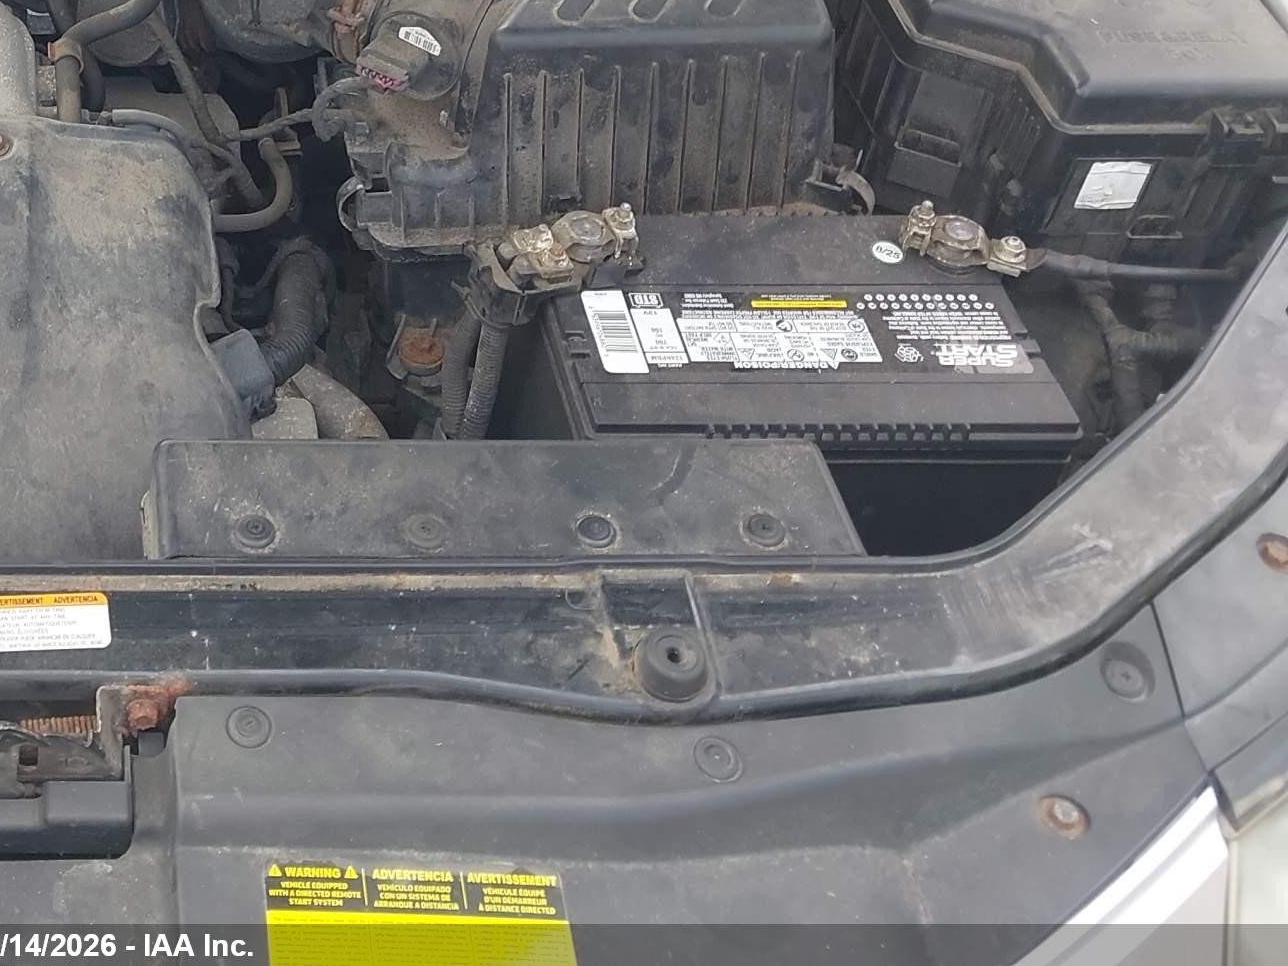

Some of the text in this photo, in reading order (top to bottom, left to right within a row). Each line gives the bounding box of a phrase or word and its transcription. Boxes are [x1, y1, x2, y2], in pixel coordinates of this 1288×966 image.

[935, 344, 1018, 358] START
[939, 355, 1013, 367] SUPER
[284, 867, 342, 878] WARNING
[372, 869, 454, 882] ADVERTENCIA
[467, 872, 558, 886] AVERTISSEMENT
[280, 881, 349, 890] VEHICLE EQUIPPED
[268, 889, 289, 897] WITH
[296, 890, 330, 898] DIRECTED
[331, 891, 362, 899] REMOTE
[409, 893, 440, 901] SISTEMA
[441, 894, 451, 902] DE
[288, 898, 343, 907] START SYSTEM
[373, 900, 460, 911] ARRANQUE A DISTANCIA
[485, 904, 520, 913] DISTANCE
[520, 905, 556, 915] DIRECTED
